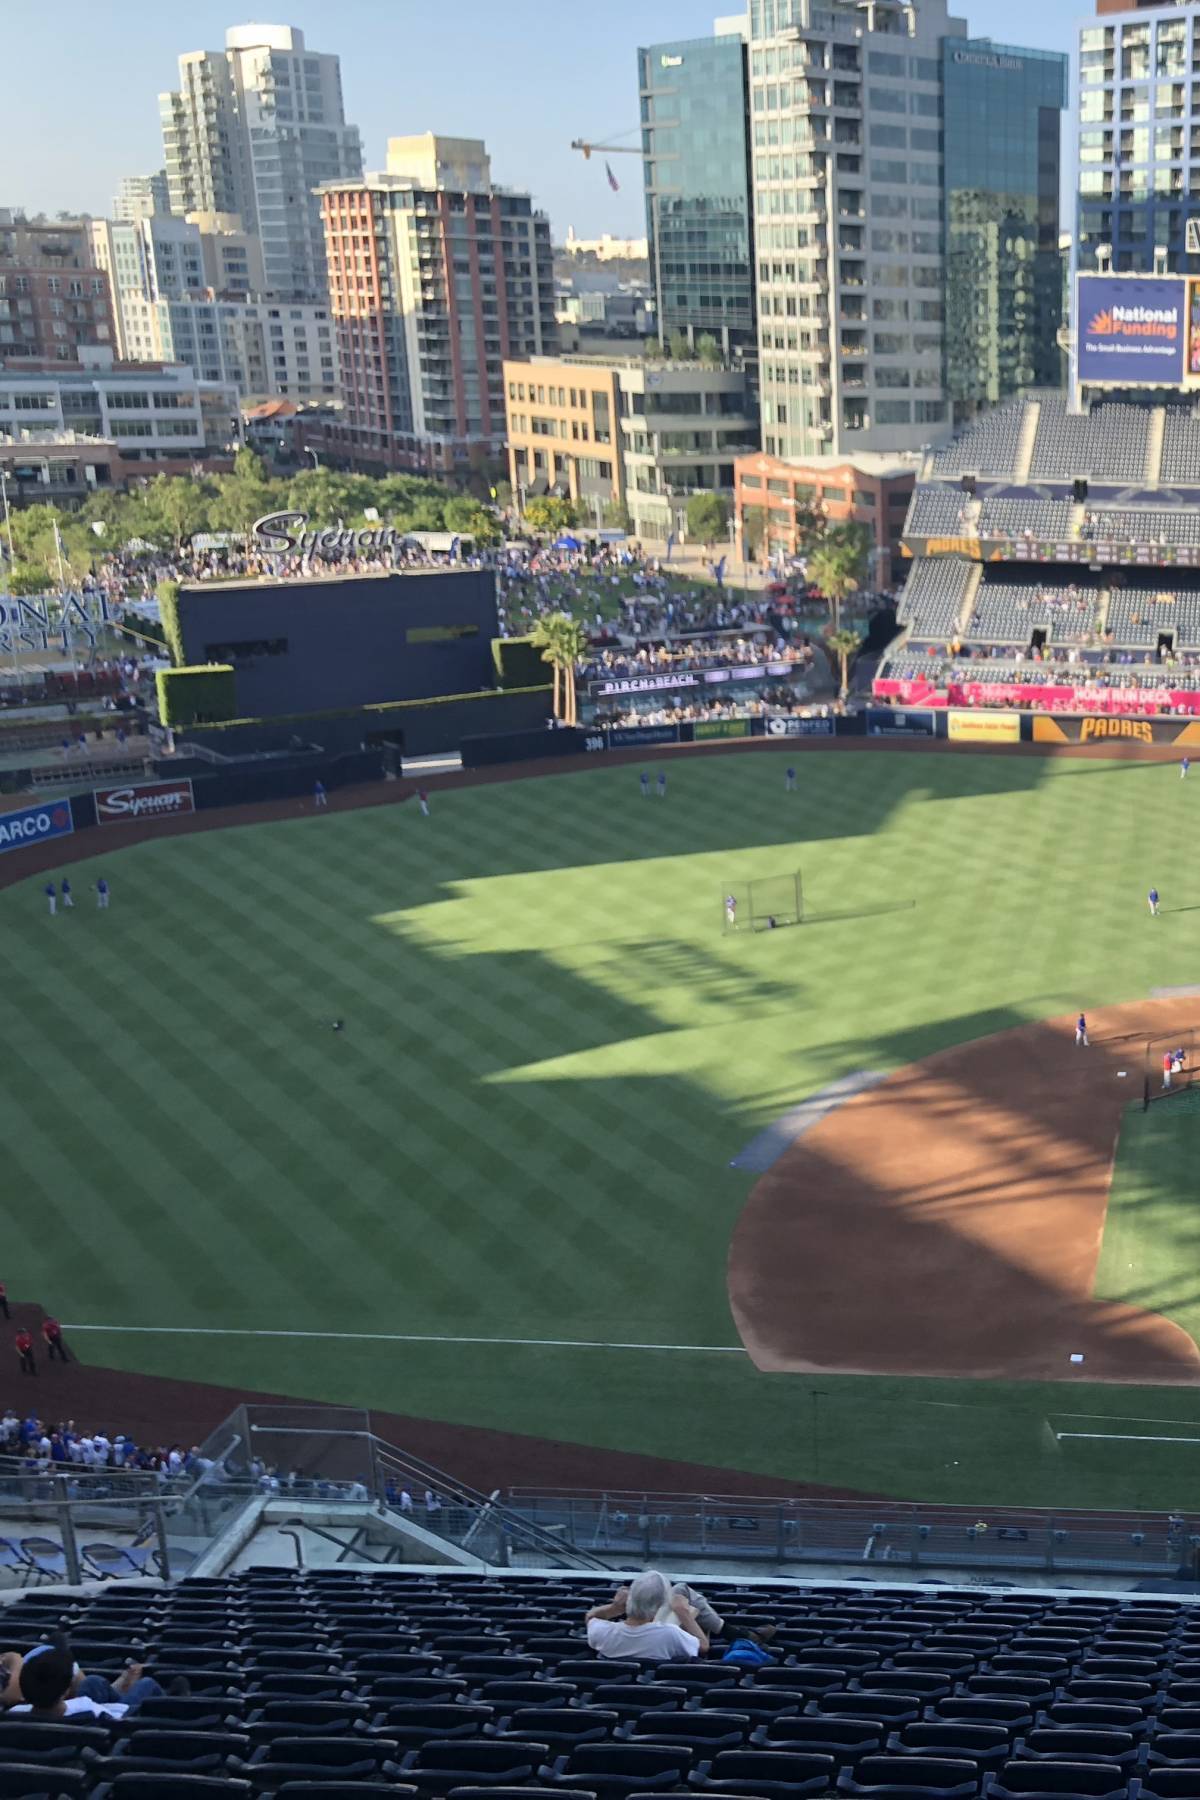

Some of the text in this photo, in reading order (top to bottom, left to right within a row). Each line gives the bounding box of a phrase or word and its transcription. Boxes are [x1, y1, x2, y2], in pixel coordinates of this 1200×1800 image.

[1112, 305, 1177, 323] National
[1112, 321, 1177, 339] Funding
[252, 510, 404, 562] Sycuan
[1111, 688, 1138, 702] RUN
[1139, 690, 1172, 704] DECK
[1080, 717, 1153, 744] PADRES
[100, 789, 186, 816] Sycuan
[0, 813, 51, 844] ARCO
